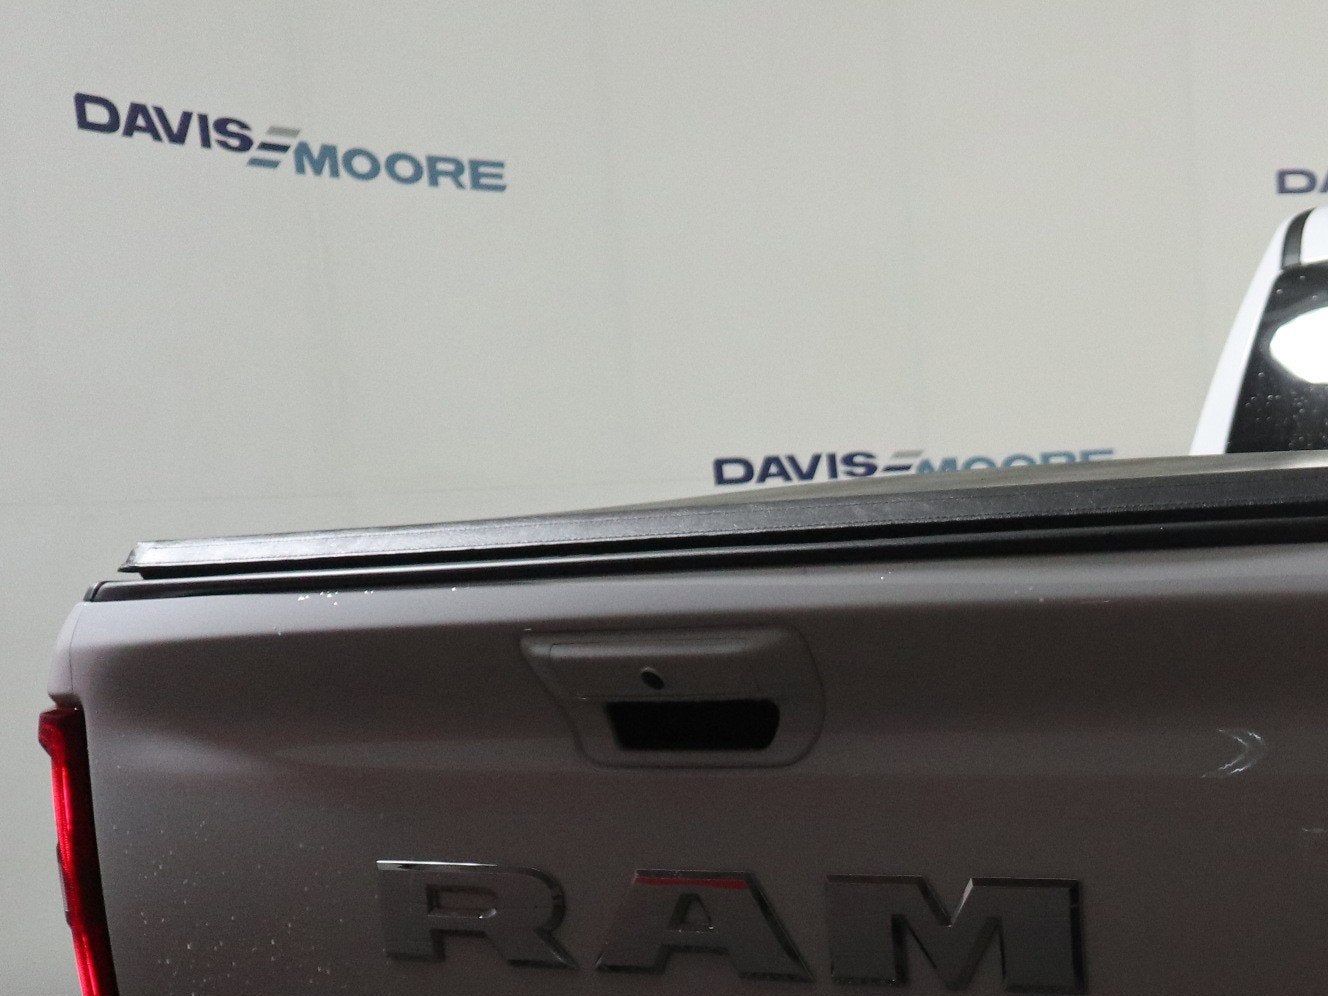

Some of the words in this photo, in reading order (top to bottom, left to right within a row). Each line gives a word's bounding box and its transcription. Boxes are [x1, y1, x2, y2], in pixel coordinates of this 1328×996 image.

[74, 92, 253, 153] DAVIS
[293, 141, 507, 192] MOORE
[712, 450, 878, 487] DAVIS
[376, 859, 1089, 993] RAM
